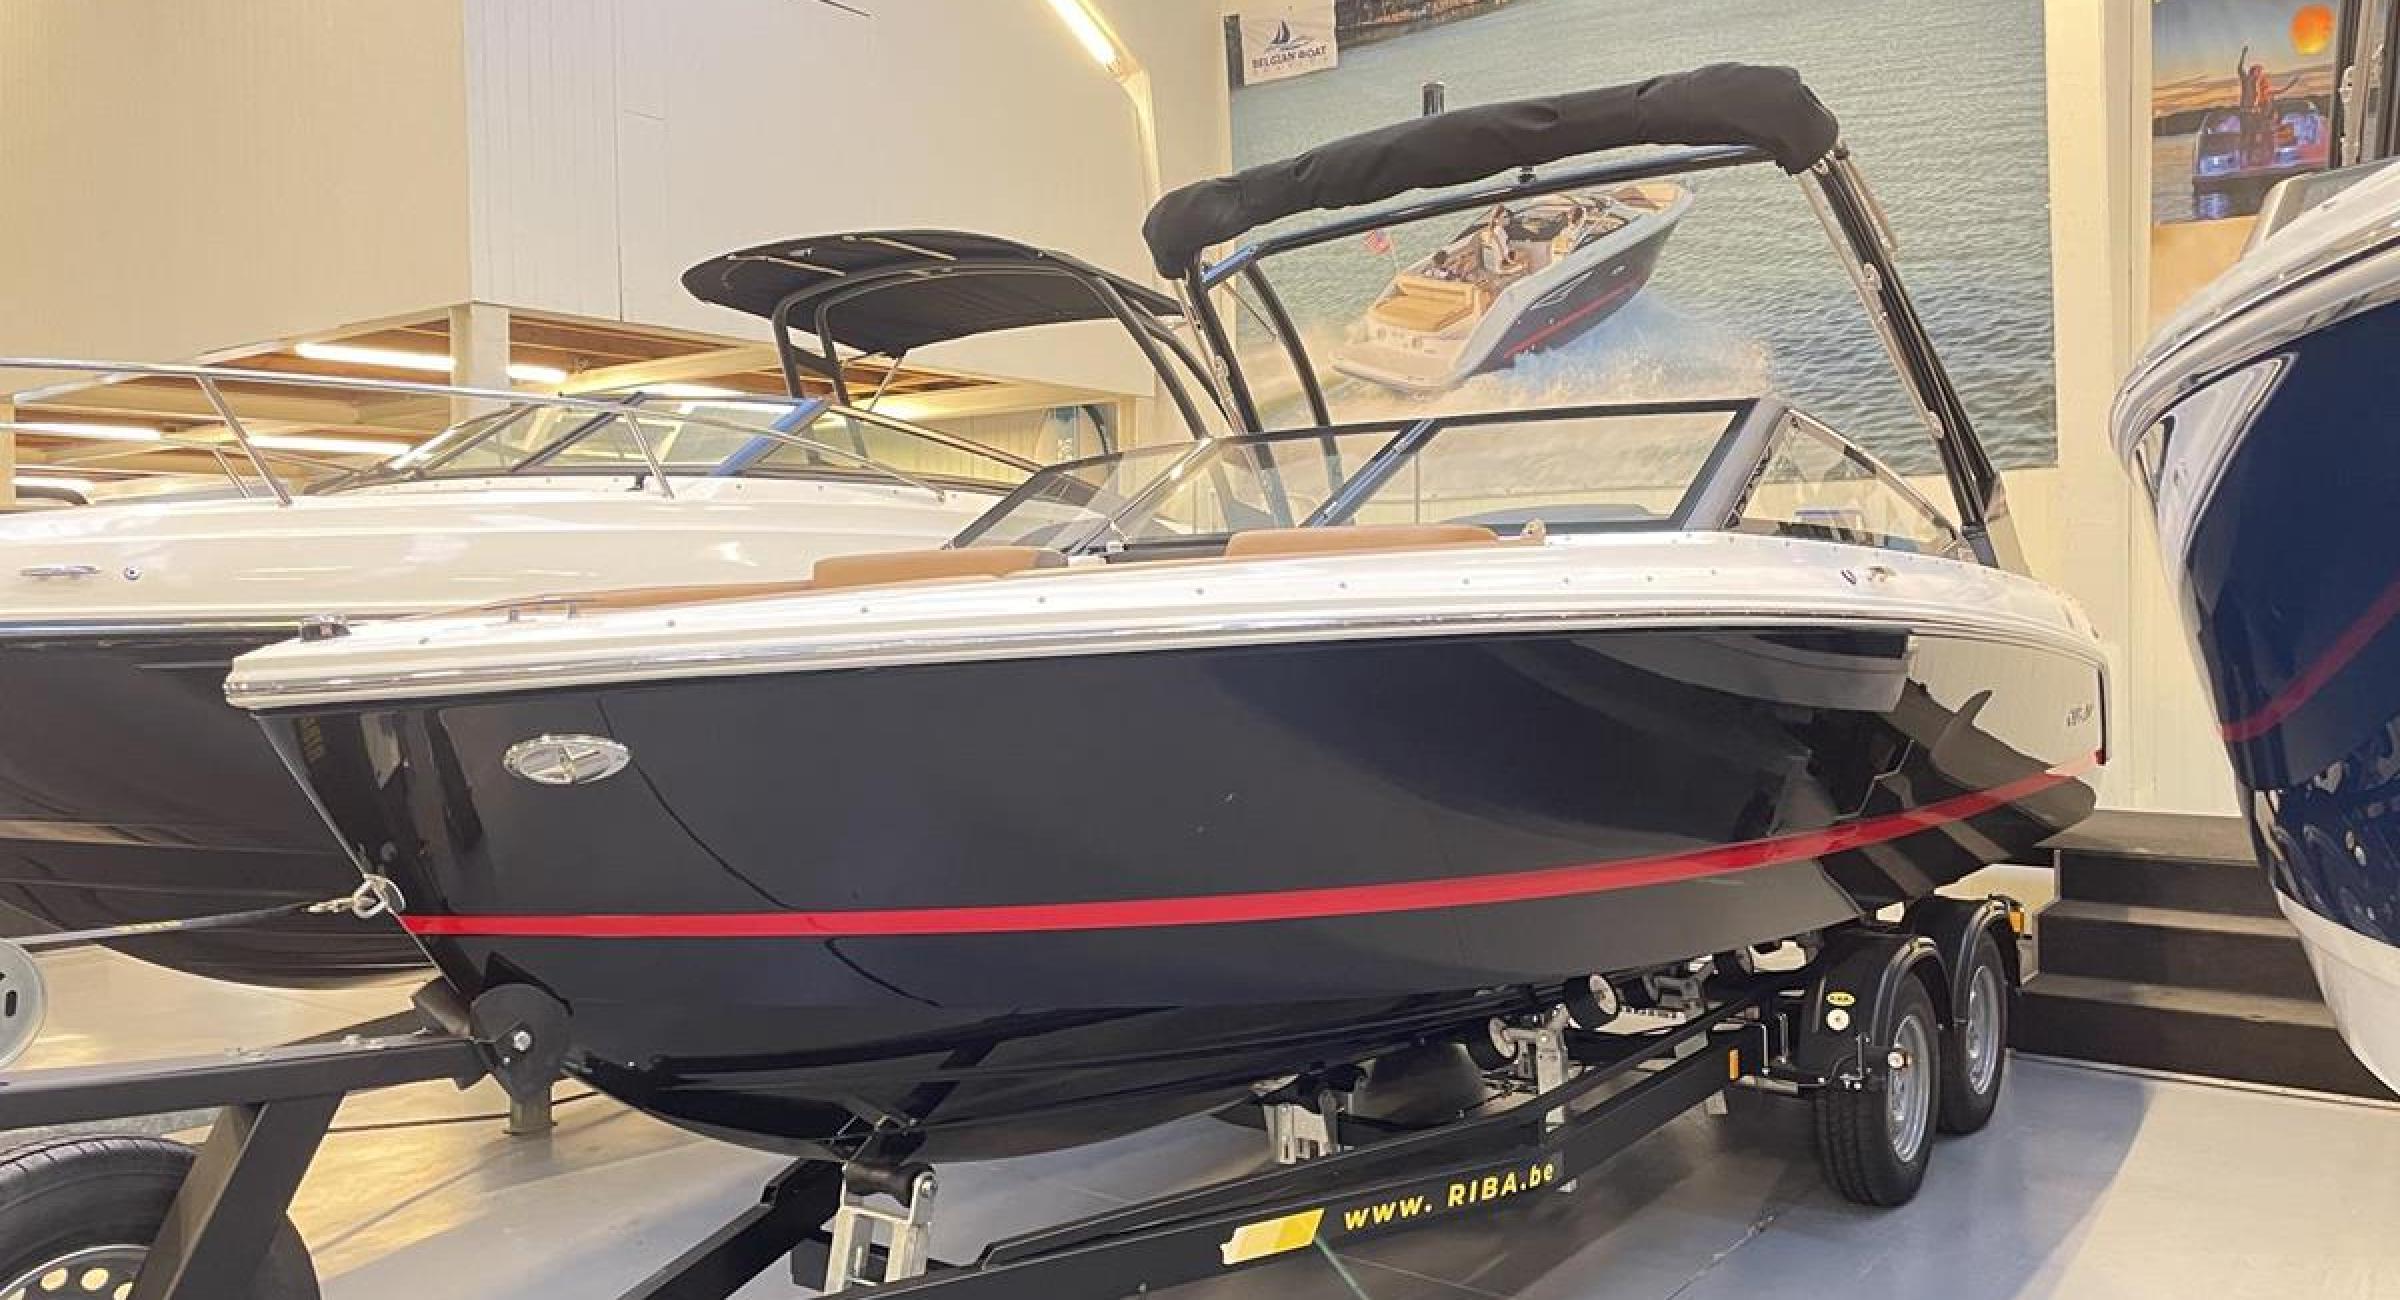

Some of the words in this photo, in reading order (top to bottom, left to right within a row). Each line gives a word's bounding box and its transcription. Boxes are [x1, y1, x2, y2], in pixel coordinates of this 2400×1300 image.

[1298, 45, 1326, 59] BOAT
[1344, 1195, 1432, 1230] www.
[1447, 1163, 1554, 1207] RIBA.be
